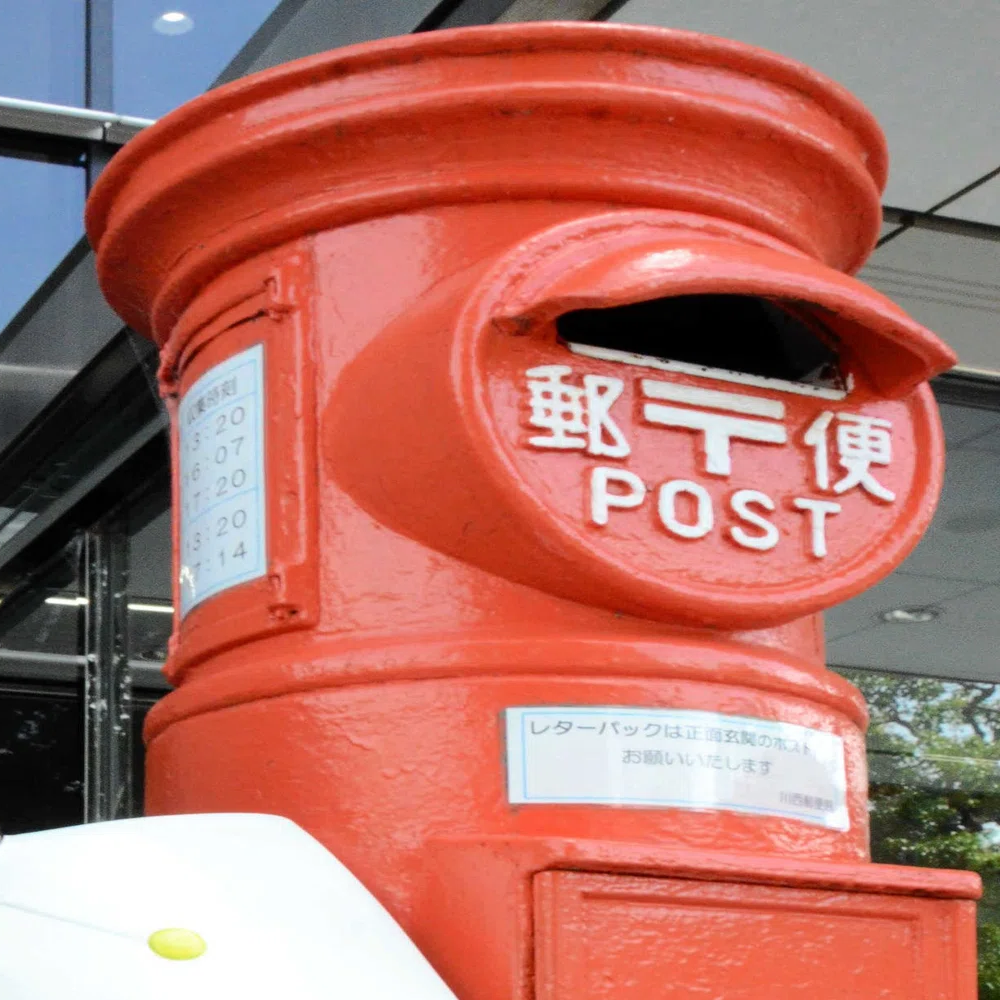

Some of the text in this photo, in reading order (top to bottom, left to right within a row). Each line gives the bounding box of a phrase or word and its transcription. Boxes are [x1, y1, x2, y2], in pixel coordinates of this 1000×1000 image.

[590, 466, 842, 559] POST
[183, 541, 248, 584] 7:14
[621, 749, 773, 776] お願いいたします
